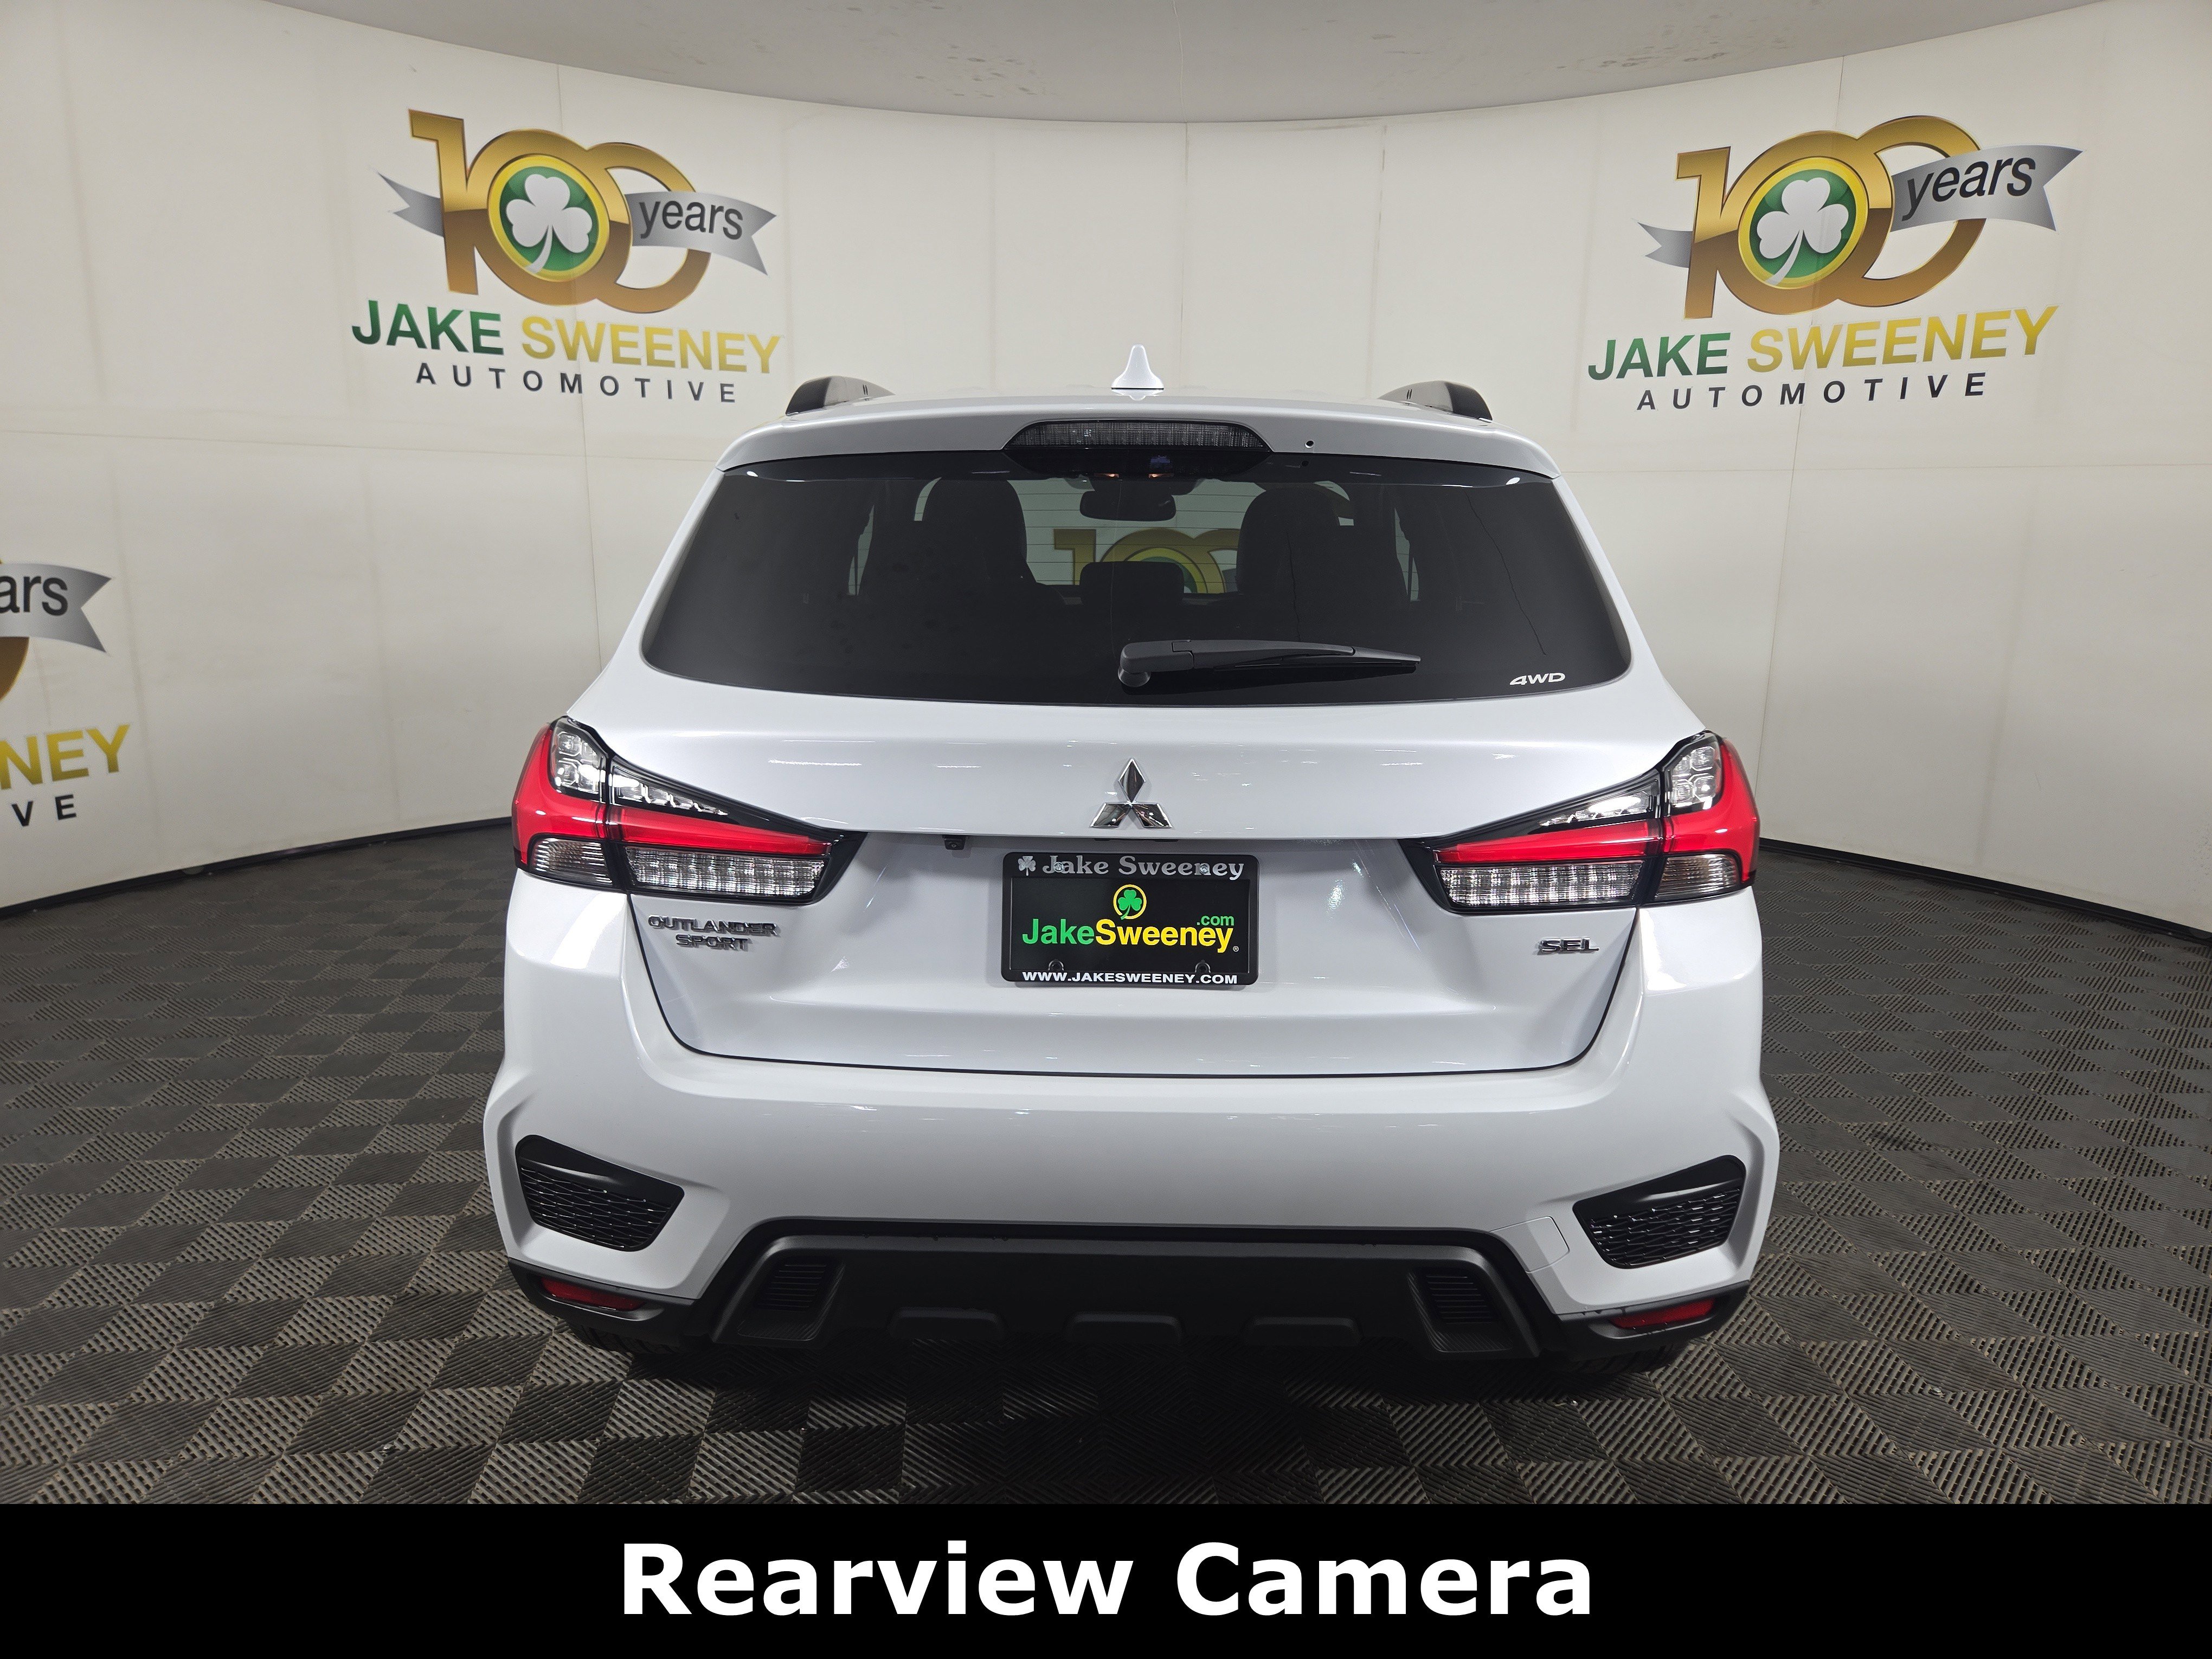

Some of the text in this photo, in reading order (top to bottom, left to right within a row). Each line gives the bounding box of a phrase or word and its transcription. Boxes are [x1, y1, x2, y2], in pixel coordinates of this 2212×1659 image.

[408, 108, 744, 313] 100 years
[1676, 115, 2035, 320] 100 years
[352, 300, 779, 374] JAKE SWEENEY
[1588, 306, 2059, 381] JAKE SWEENEY
[416, 363, 736, 403] AUTOMOTIVE
[1637, 372, 1986, 410] AUTOMOTIVE
[0, 576, 68, 616] ars
[1509, 672, 1566, 685] 4WD
[1043, 855, 1244, 880] Jake Sweeney
[648, 915, 779, 936] OUTLANDER
[1197, 915, 1234, 926] .com
[676, 934, 750, 950] SPORT
[1540, 937, 1600, 953] SEL
[1023, 972, 1238, 985] WWW.JAKESWEENEY.COM
